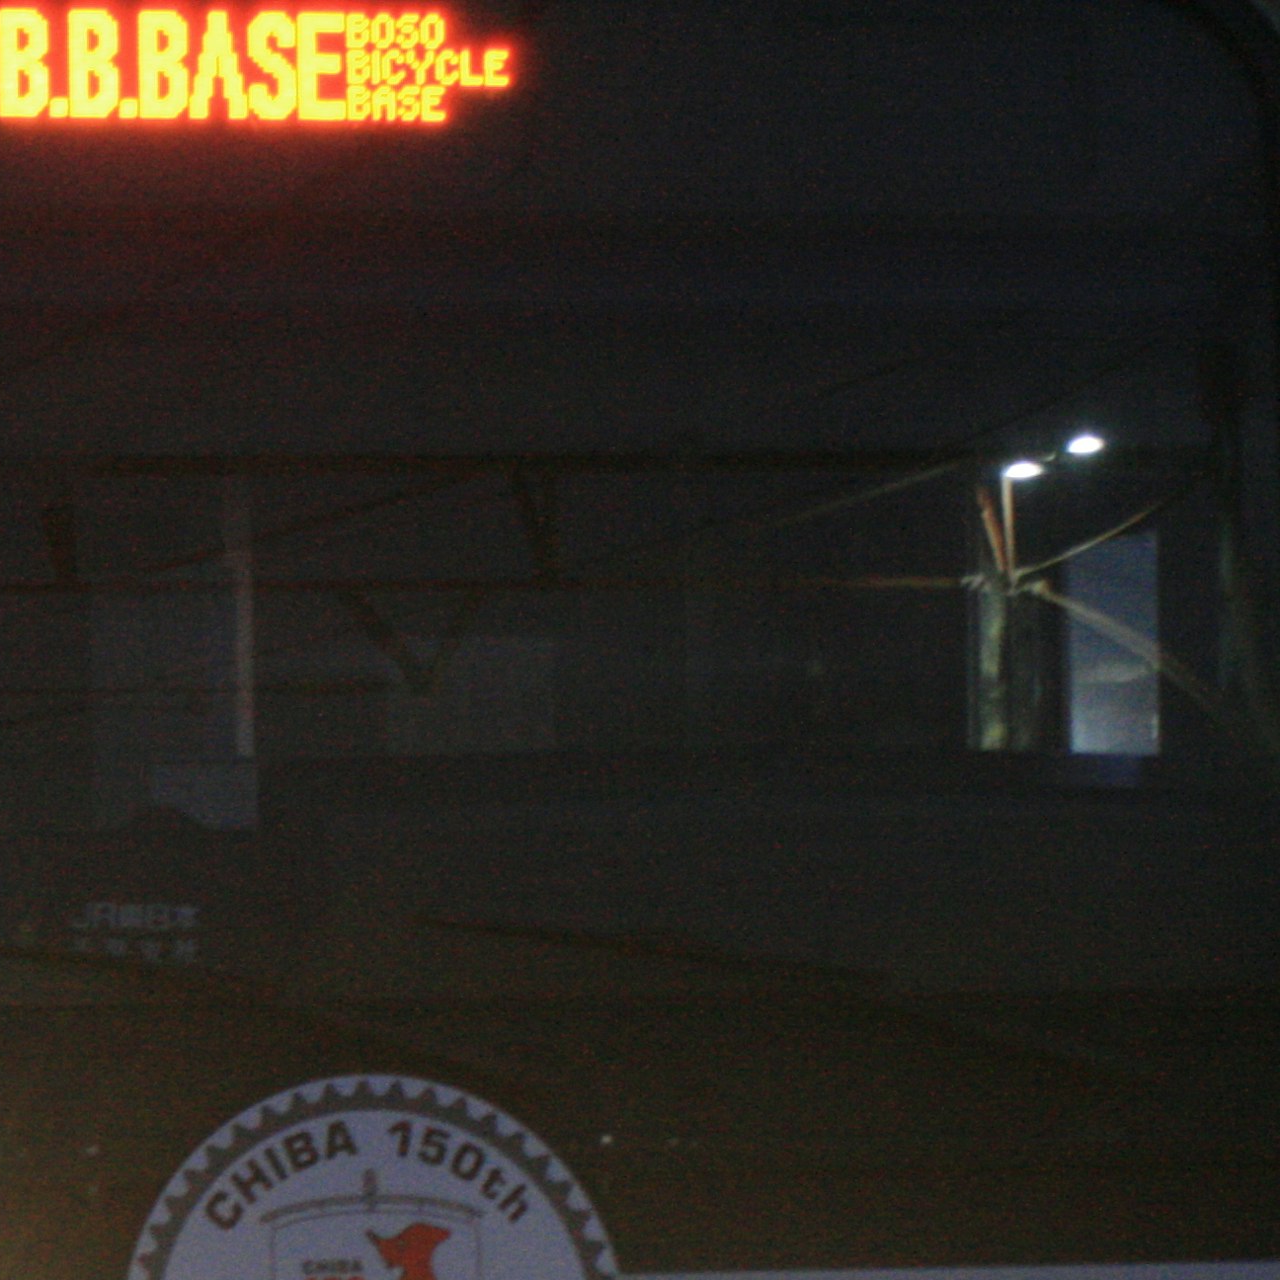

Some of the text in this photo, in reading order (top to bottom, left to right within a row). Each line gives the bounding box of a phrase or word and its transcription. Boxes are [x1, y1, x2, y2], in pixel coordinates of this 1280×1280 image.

[345, 13, 445, 50] BOSO
[345, 48, 510, 88] BICYCLE
[345, 84, 447, 122] BASE
[203, 1119, 531, 1231] CHIBA 150th
